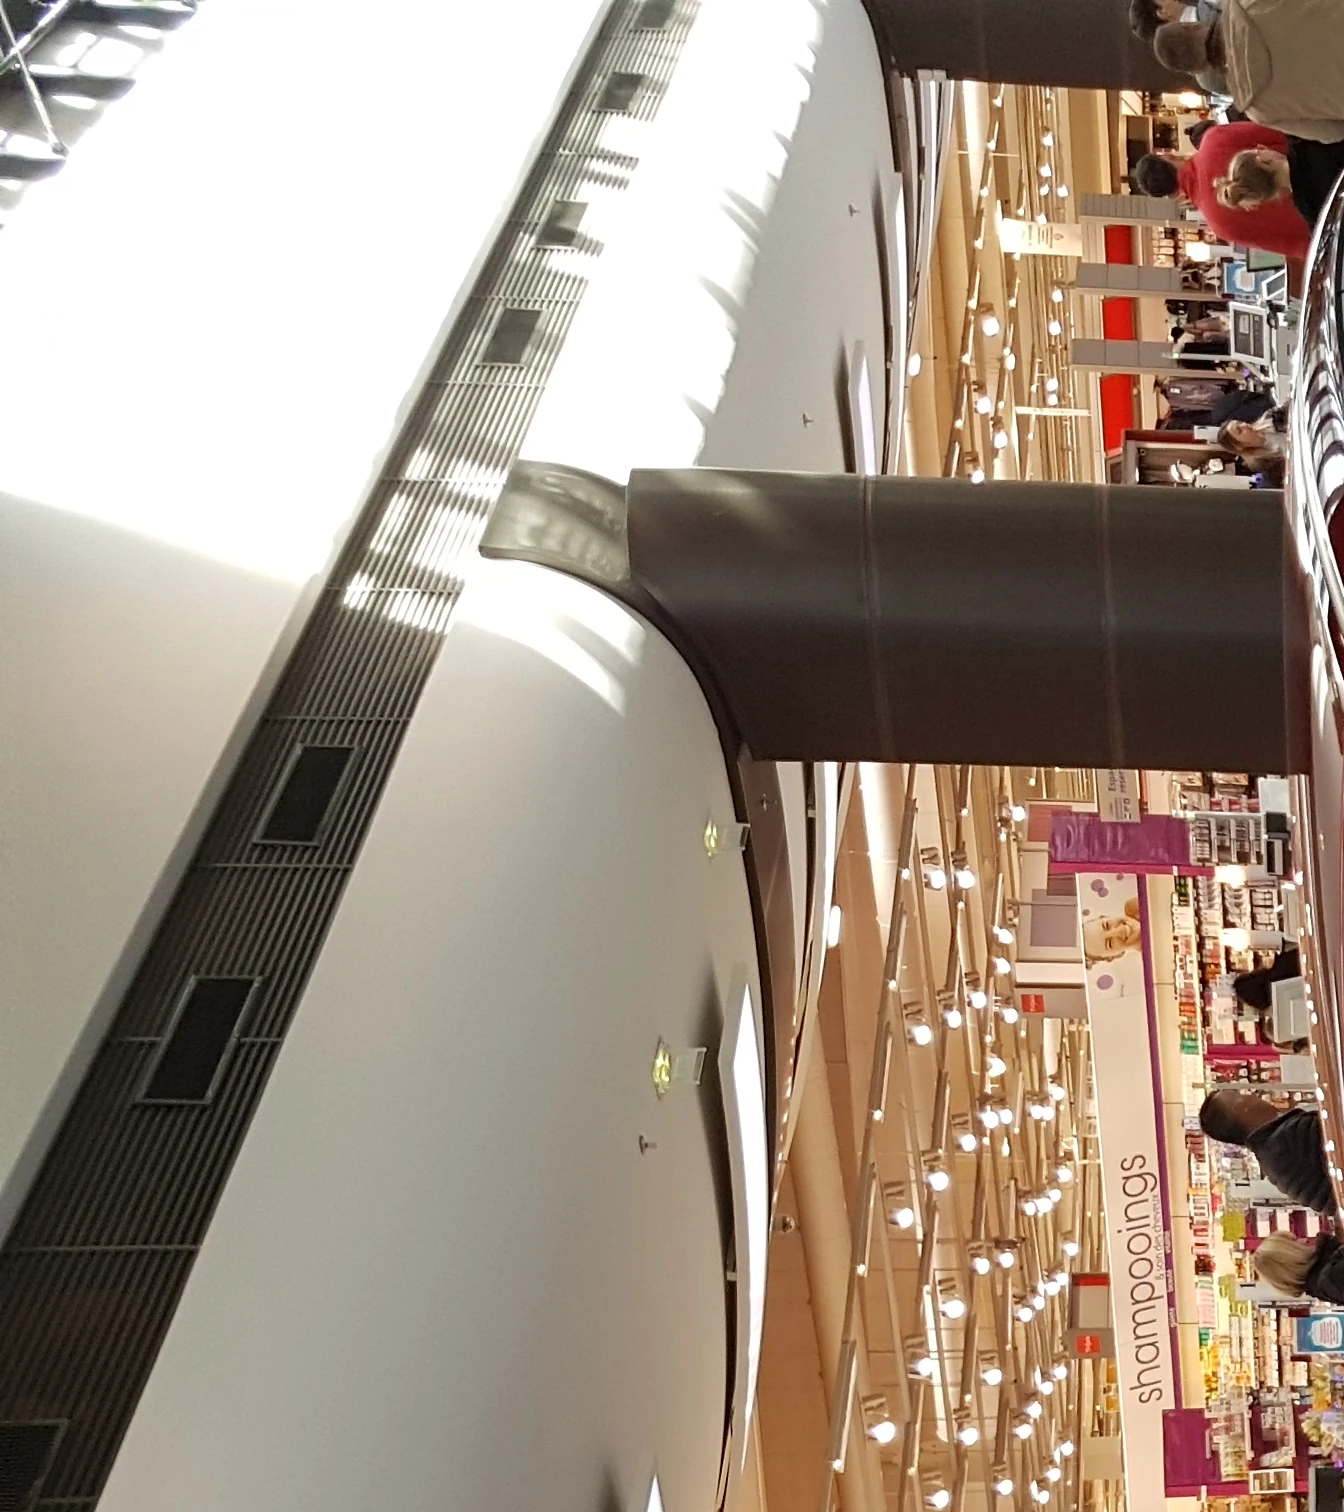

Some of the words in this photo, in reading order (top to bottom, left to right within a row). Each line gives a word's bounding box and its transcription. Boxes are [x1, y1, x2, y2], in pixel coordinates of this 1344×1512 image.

[1151, 1194, 1162, 1232] cheveux
[1153, 1234, 1162, 1251] des
[1154, 1254, 1163, 1272] soin
[1116, 1154, 1164, 1404] shampooings
